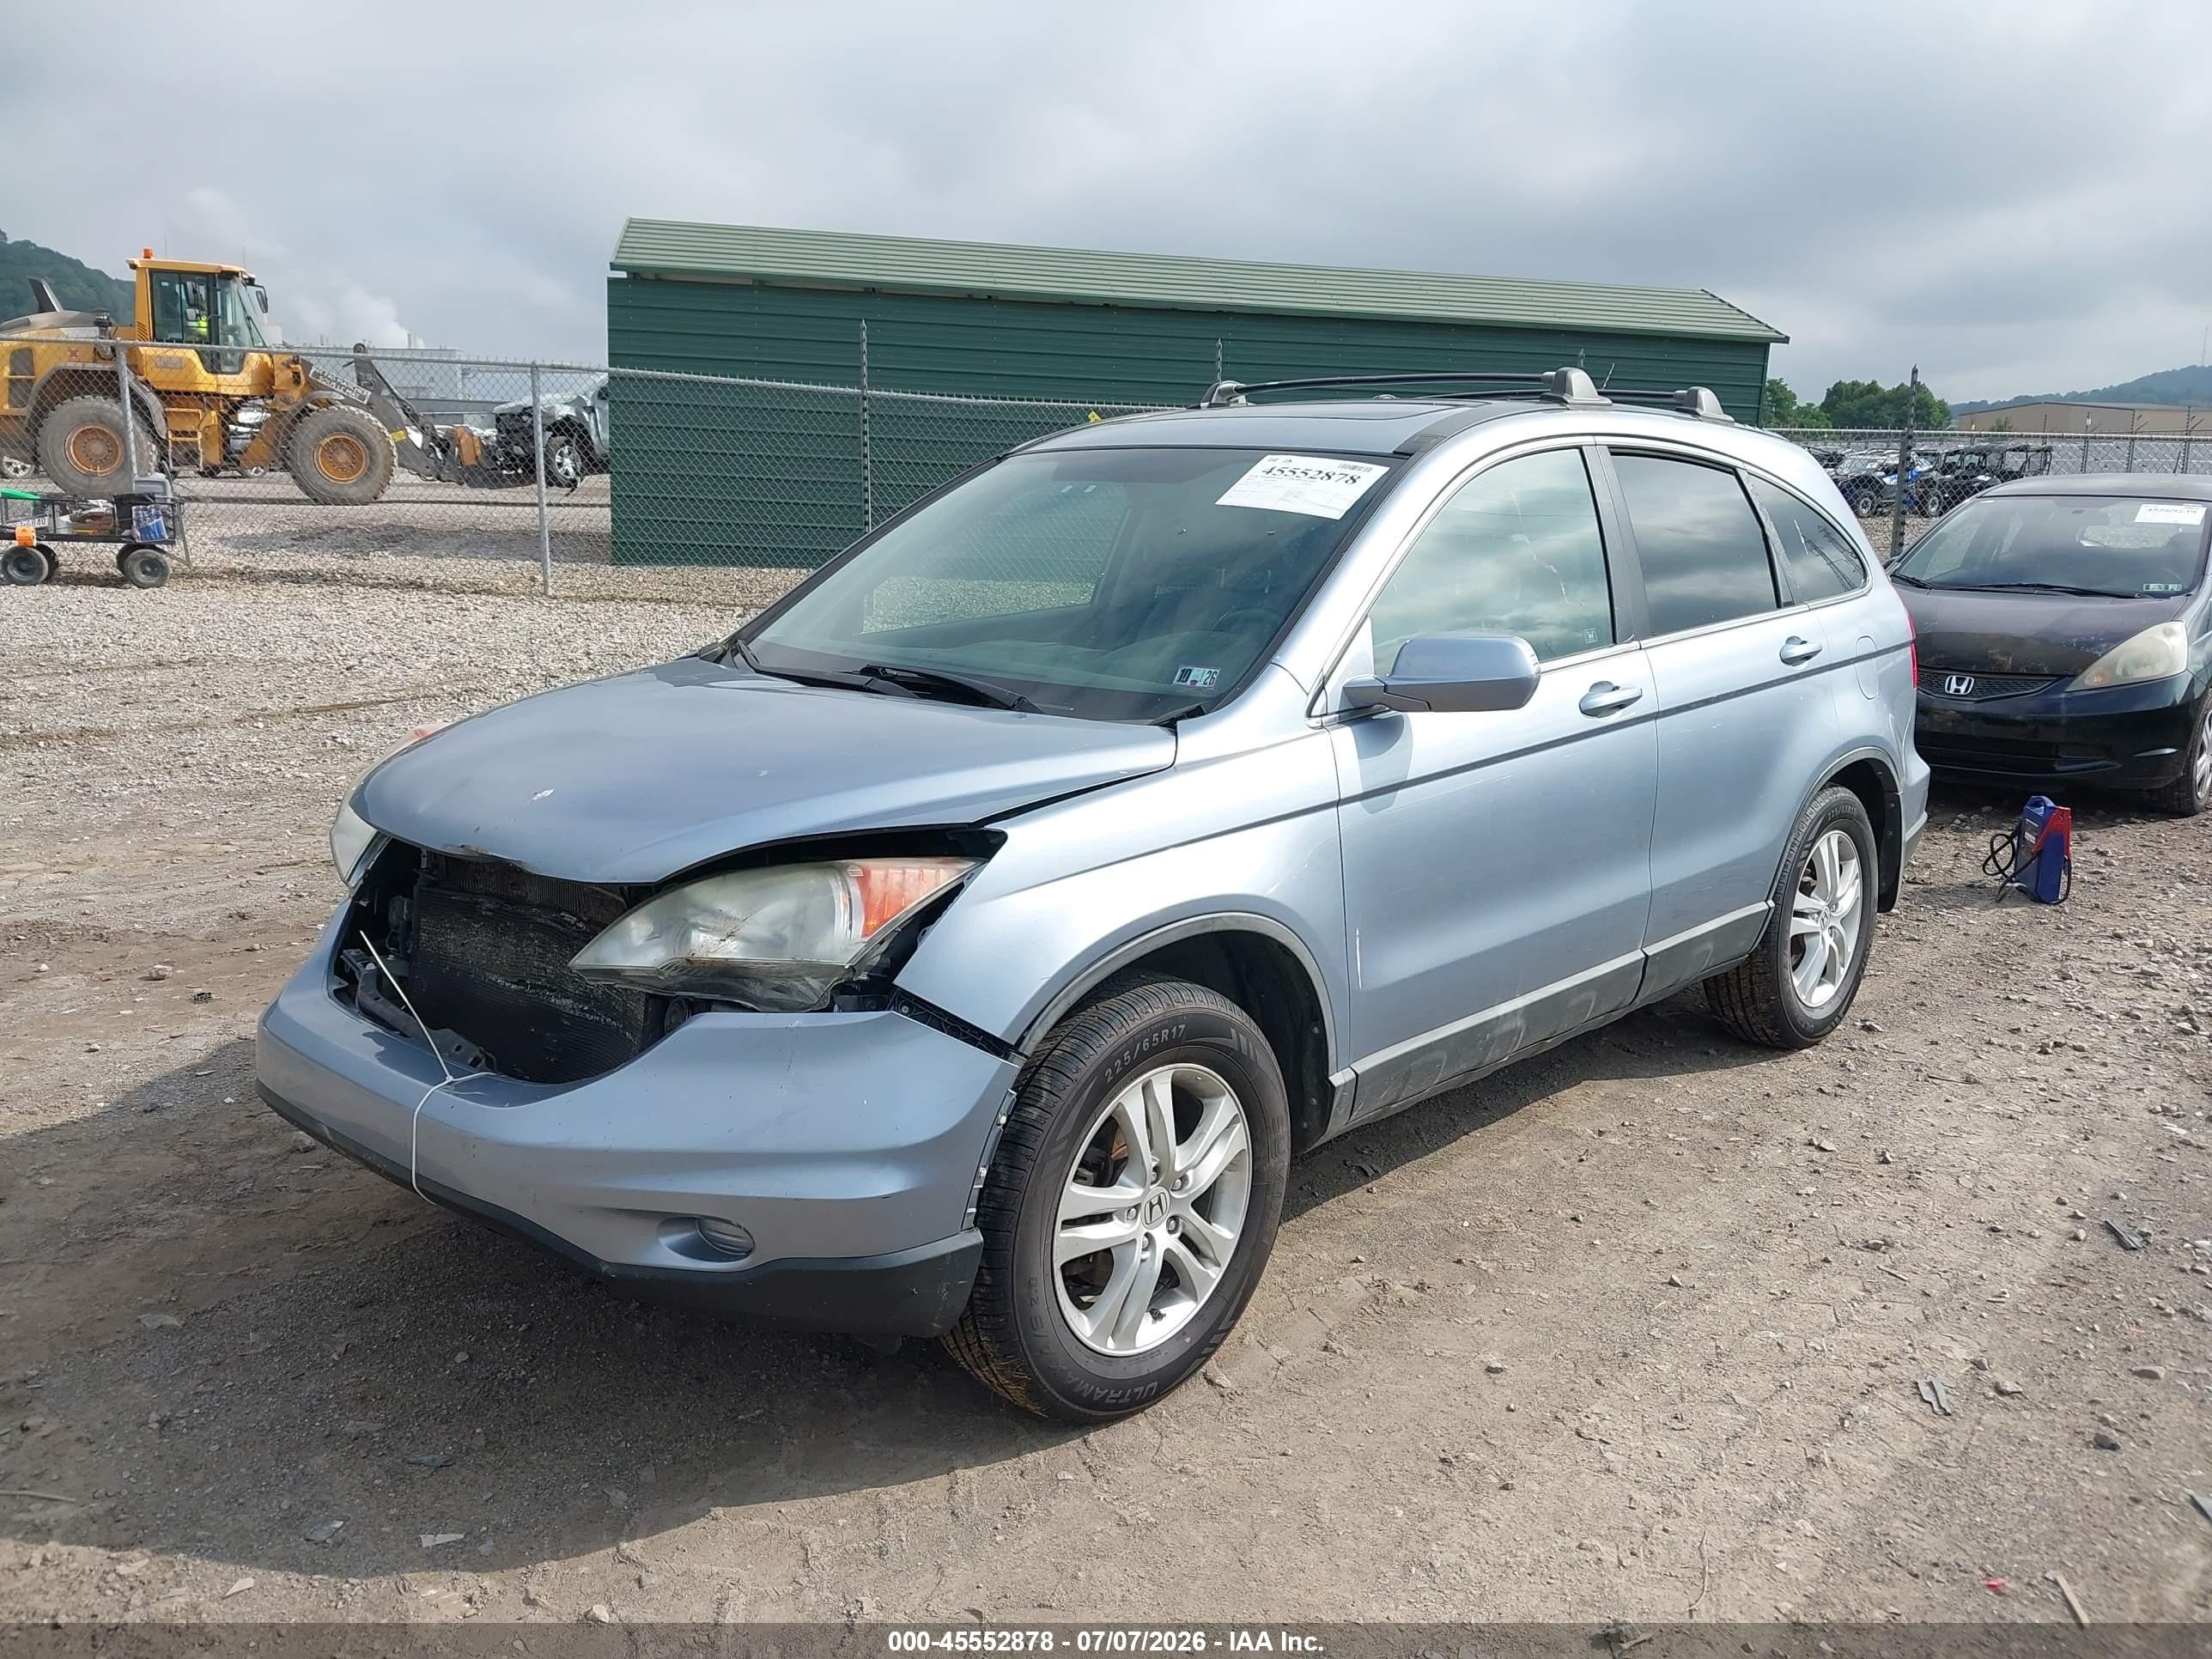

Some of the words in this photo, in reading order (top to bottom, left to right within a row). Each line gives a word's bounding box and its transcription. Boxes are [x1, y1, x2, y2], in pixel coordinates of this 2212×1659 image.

[1262, 466, 1361, 484] 45552878
[1204, 671, 1218, 685] 26
[1105, 1024, 1186, 1084] 225/65R17
